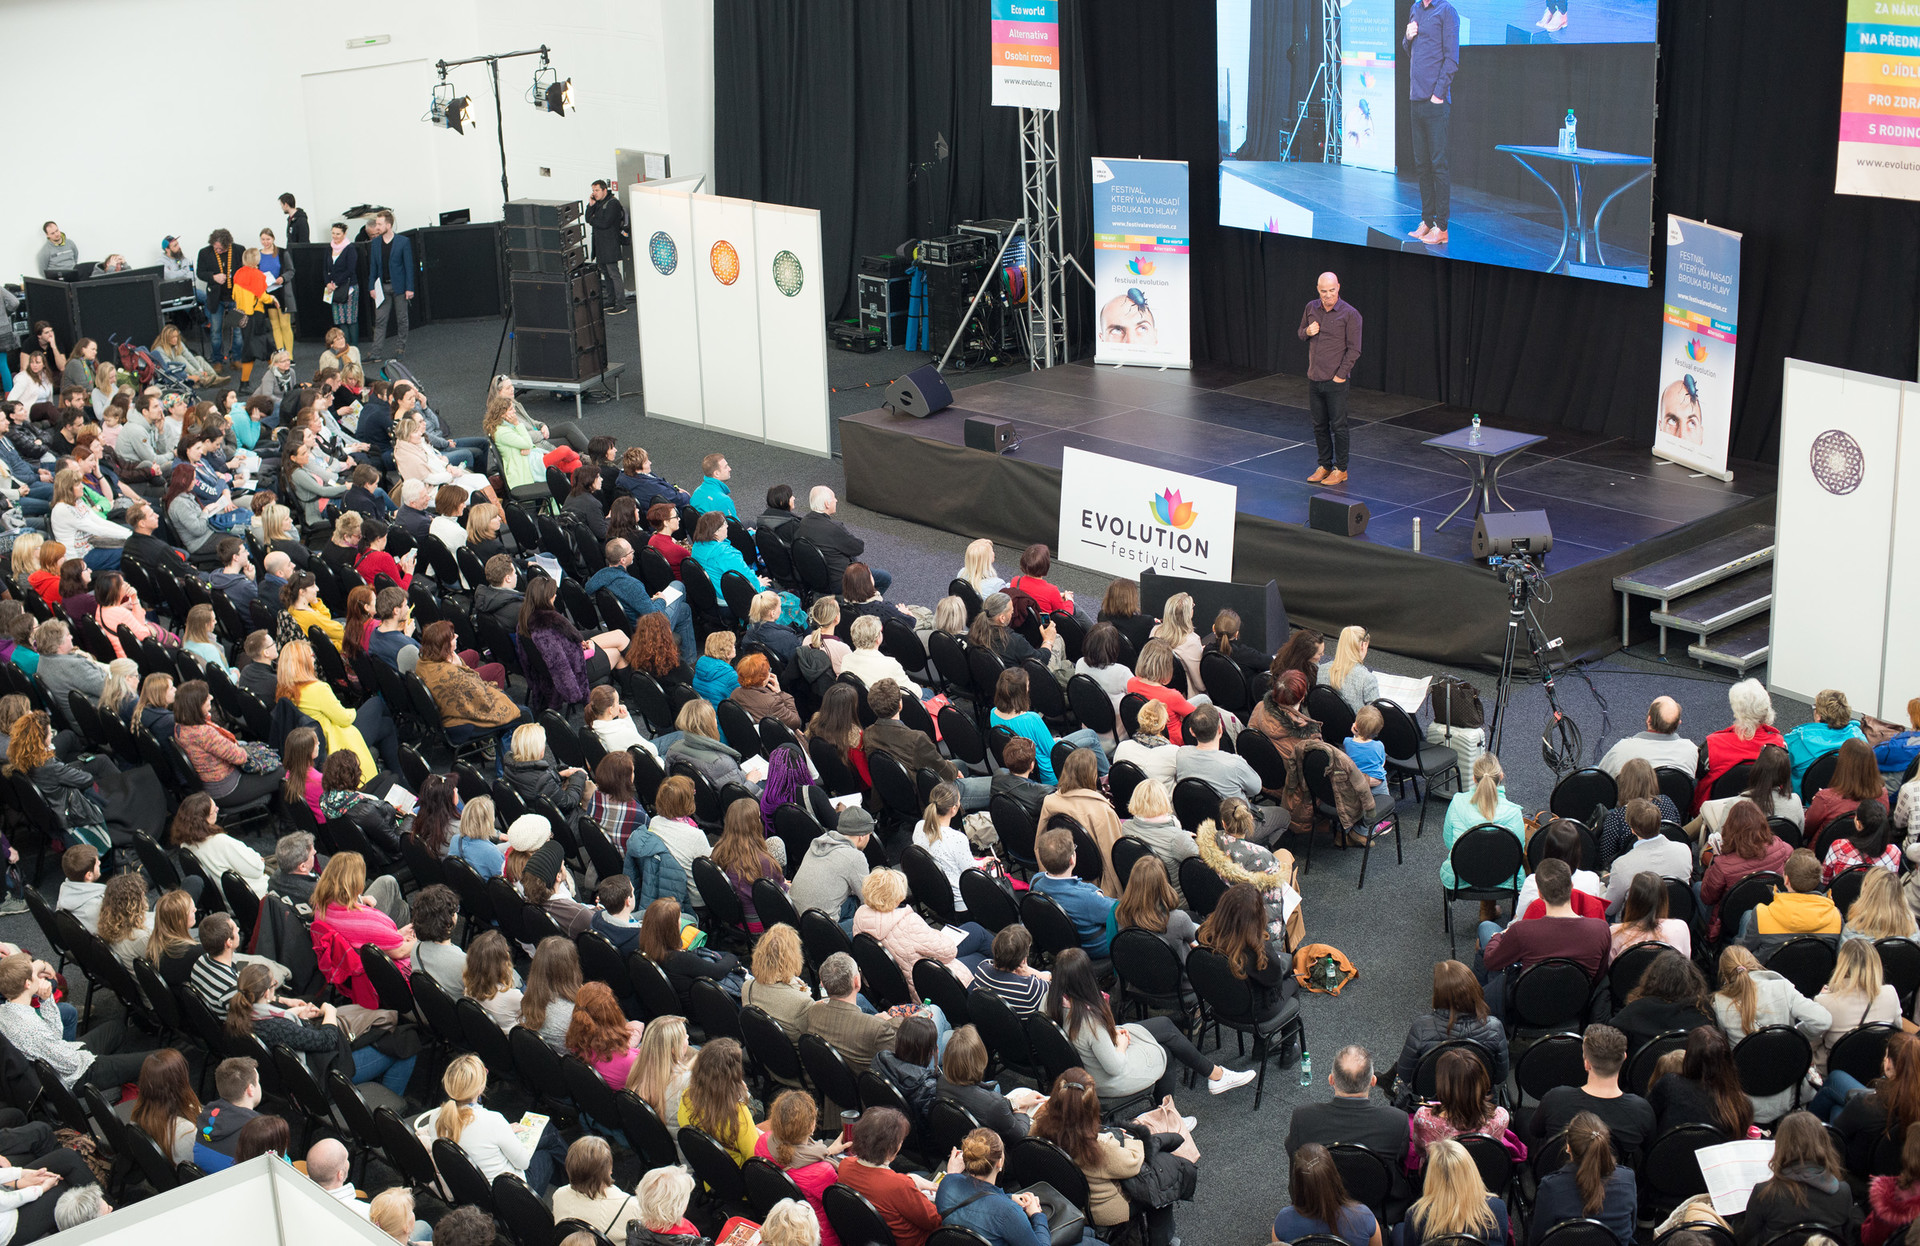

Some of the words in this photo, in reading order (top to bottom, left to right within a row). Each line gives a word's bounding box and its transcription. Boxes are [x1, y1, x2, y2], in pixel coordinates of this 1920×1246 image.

[1010, 4, 1022, 14] Eco
[1023, 6, 1045, 16] world
[1875, 2, 1889, 15] ZA
[1008, 28, 1048, 40] Alternativa
[1860, 32, 1878, 45] NA
[1880, 31, 1920, 49] PŘEDN
[1031, 54, 1052, 65] rozvoj
[1882, 64, 1890, 75] O
[1004, 78, 1052, 88] www.evolution.cz
[1868, 93, 1892, 106] PRO
[1868, 124, 1876, 135] S
[1111, 205, 1142, 214] BROUKA
[1143, 206, 1154, 214] DO
[1156, 207, 1178, 216] HLAVY
[1678, 273, 1701, 287] BROUKA
[1702, 280, 1712, 290] DO
[1712, 284, 1730, 296] HLAVY
[1674, 358, 1692, 370] festival
[1694, 366, 1716, 378] evolution
[1082, 509, 1209, 559] EVOLUTION
[1111, 541, 1175, 571] festival
